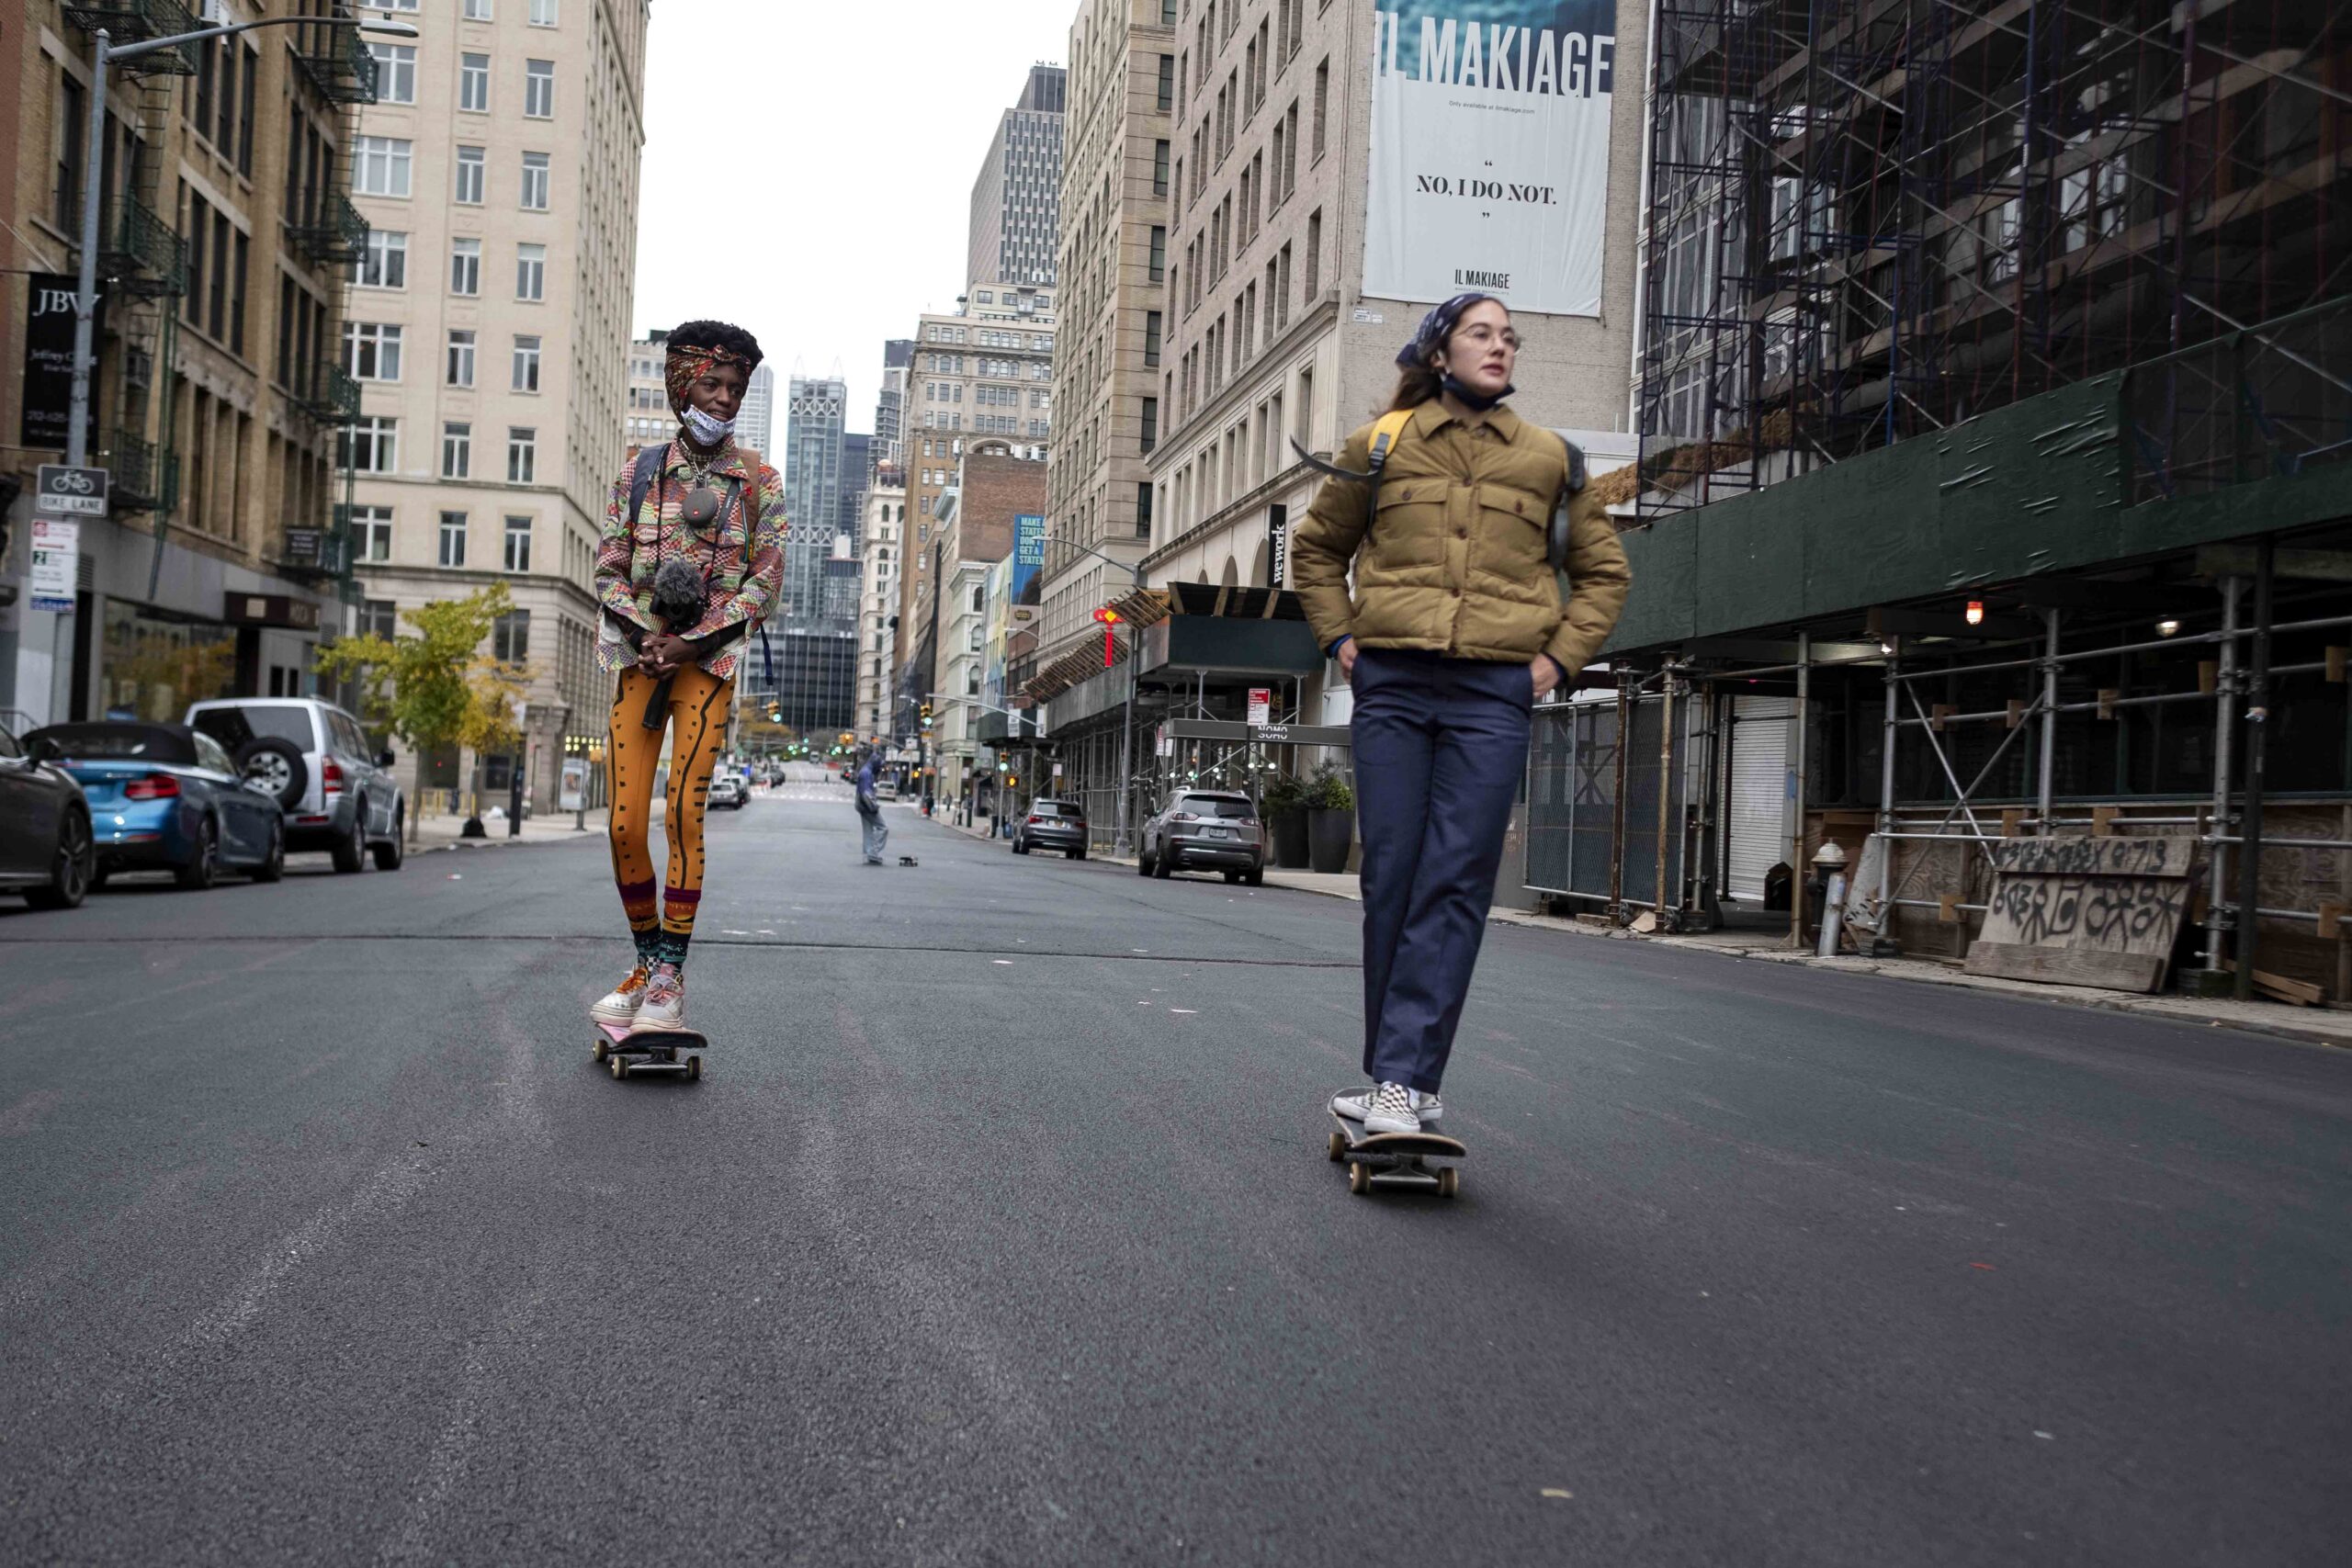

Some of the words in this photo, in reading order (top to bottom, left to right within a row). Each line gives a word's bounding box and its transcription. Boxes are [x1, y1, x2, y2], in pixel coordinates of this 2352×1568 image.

[1374, 11, 1407, 81] IL
[1419, 17, 1615, 99] MAKIAGE
[1416, 175, 1453, 197] NO,
[1458, 178, 1465, 197] I
[1471, 179, 1503, 200] DO
[1508, 183, 1557, 205] NOT.
[1454, 268, 1464, 285] IL
[1465, 269, 1510, 289] MAKIAGE
[41, 496, 65, 509] BIKE
[72, 499, 100, 512] LANE
[1271, 524, 1285, 584] wework
